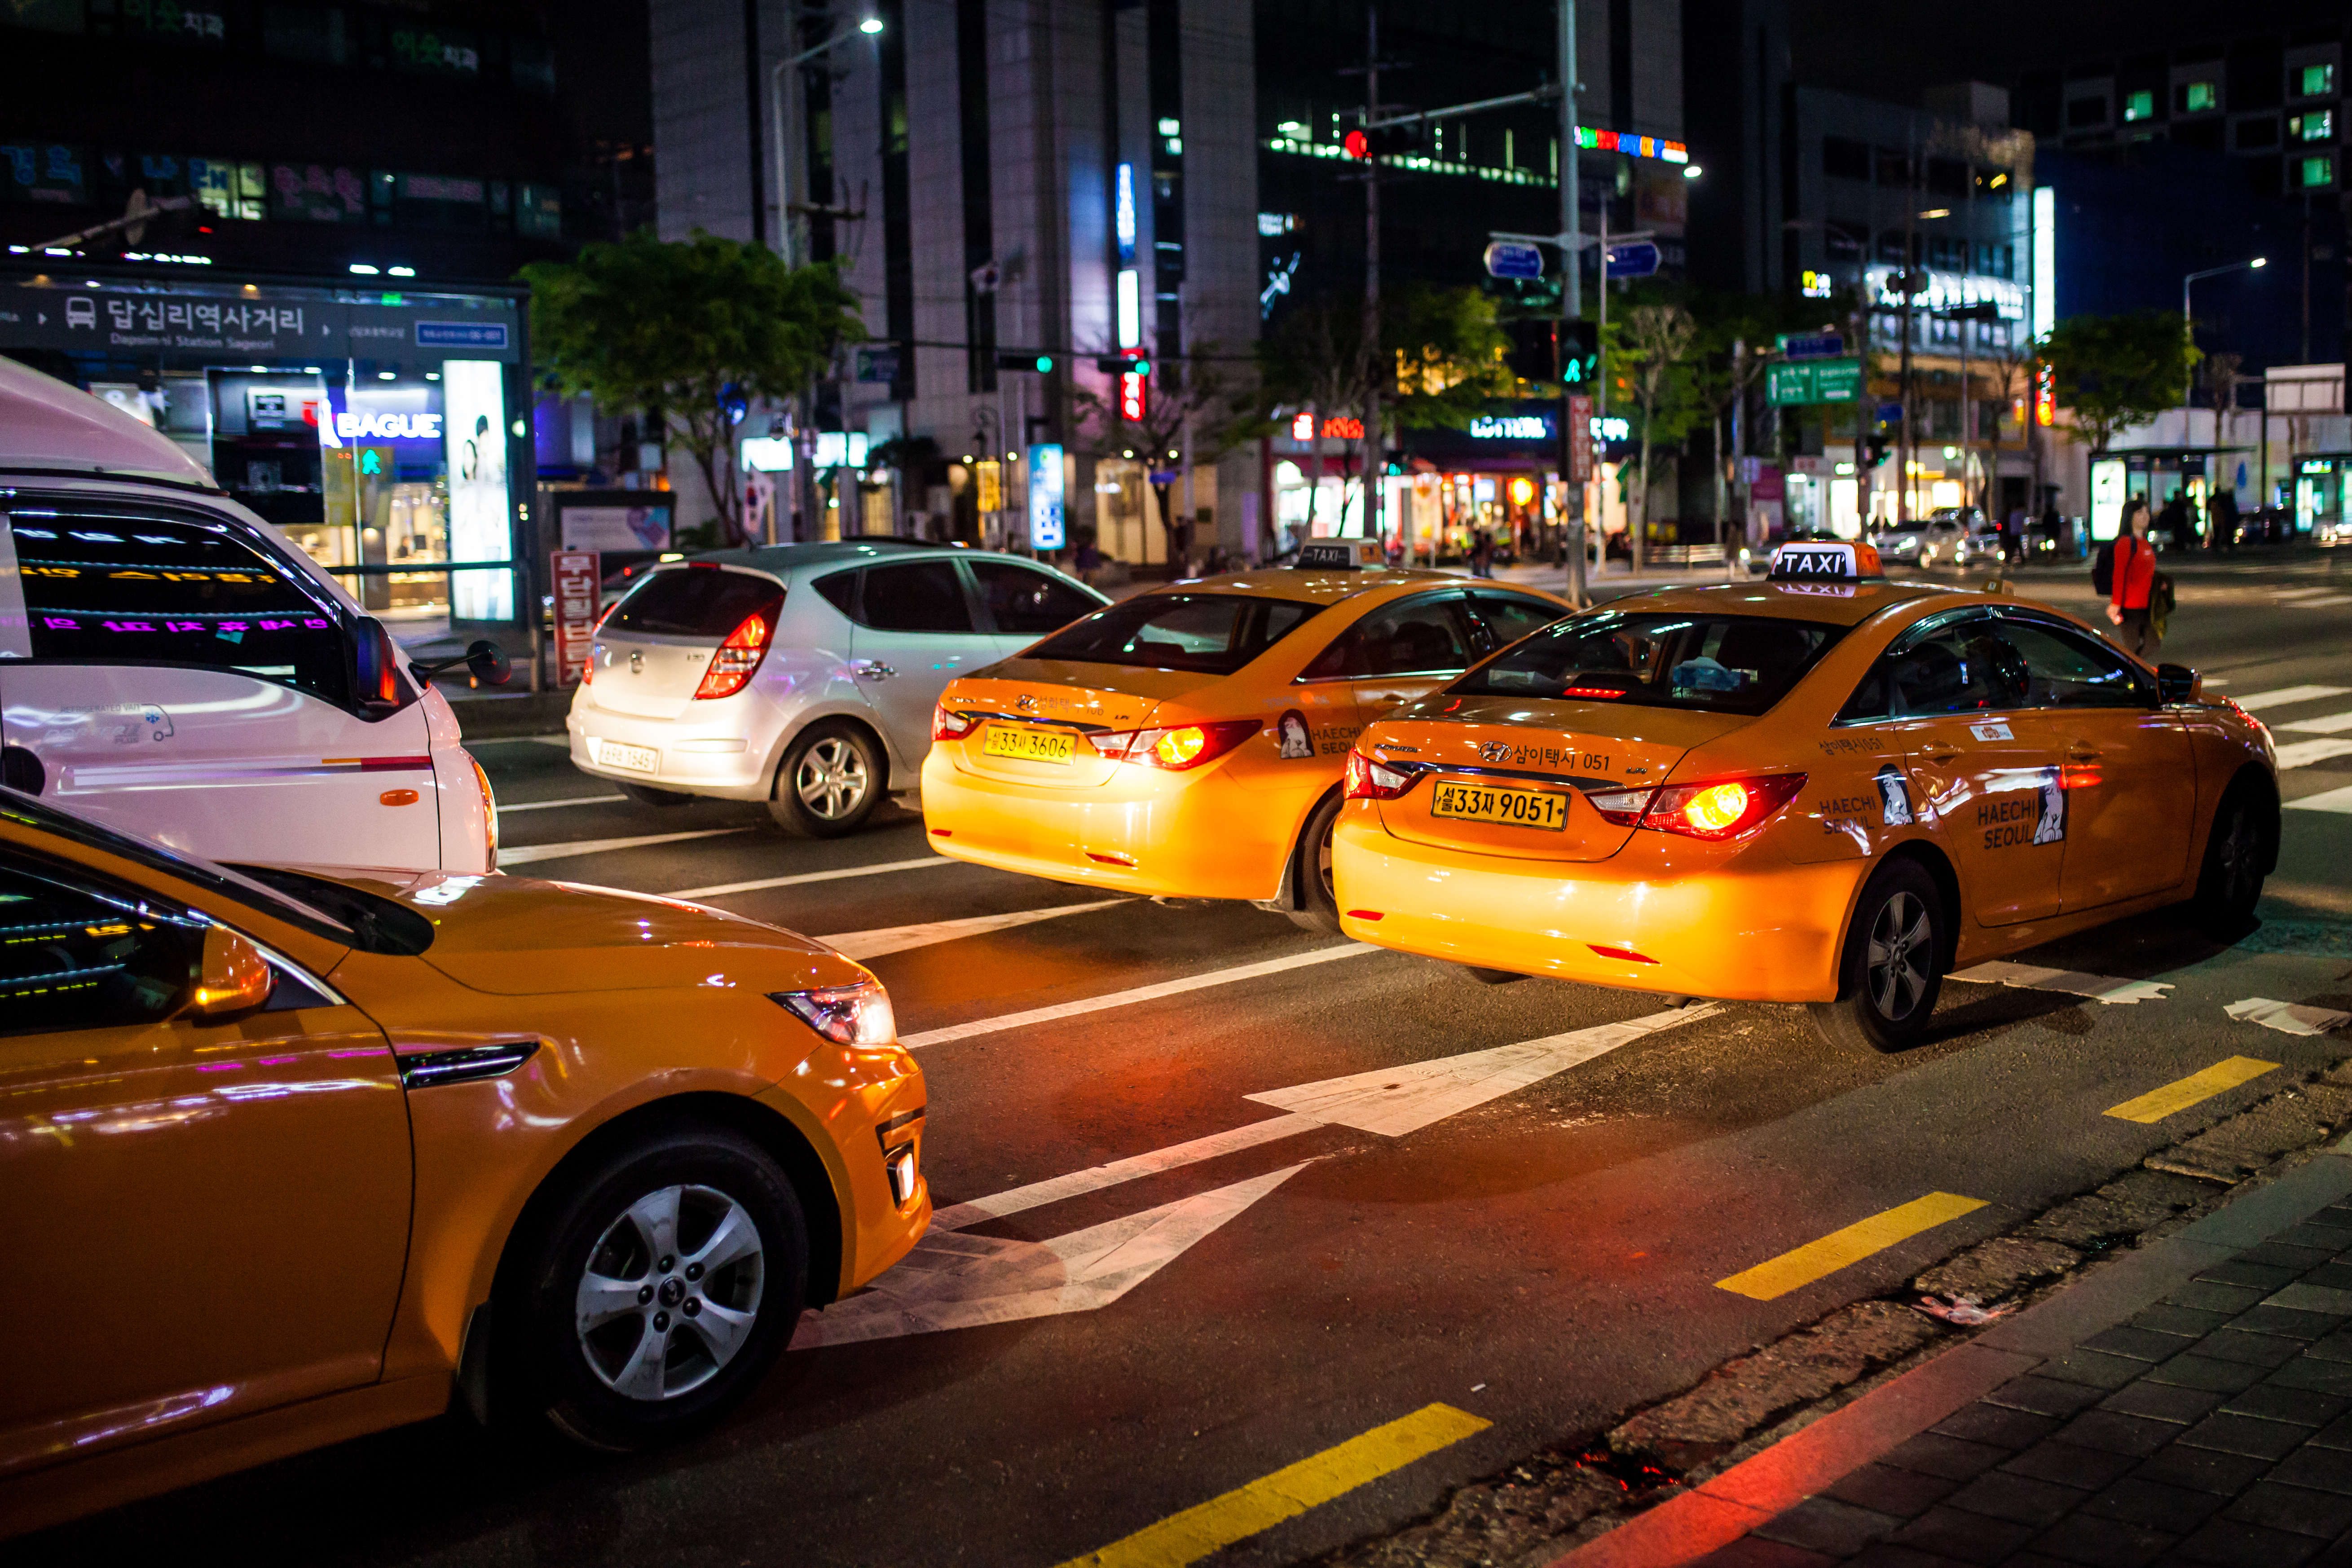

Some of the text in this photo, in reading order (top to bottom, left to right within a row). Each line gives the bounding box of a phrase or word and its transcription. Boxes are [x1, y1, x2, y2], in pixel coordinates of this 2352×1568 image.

[107, 300, 304, 335] 답십리역사거리
[176, 335, 224, 348] Station
[337, 412, 442, 438] BAGUE
[1313, 548, 1339, 561] TAXI
[1784, 554, 1841, 573] TAXI
[1310, 727, 1361, 741] HAECHI
[1029, 736, 1066, 758] 3606
[1321, 741, 1352, 755] SEO
[628, 750, 650, 768] 1545
[1514, 745, 1610, 771] 삼이택시 051
[1441, 787, 1455, 811] 서울
[1500, 793, 1554, 823] 9051
[1819, 797, 1876, 814] HAECHI
[1978, 799, 2035, 826] HAECHI
[1823, 815, 1875, 835] SEOUL
[1984, 824, 2033, 850] SEOUL
